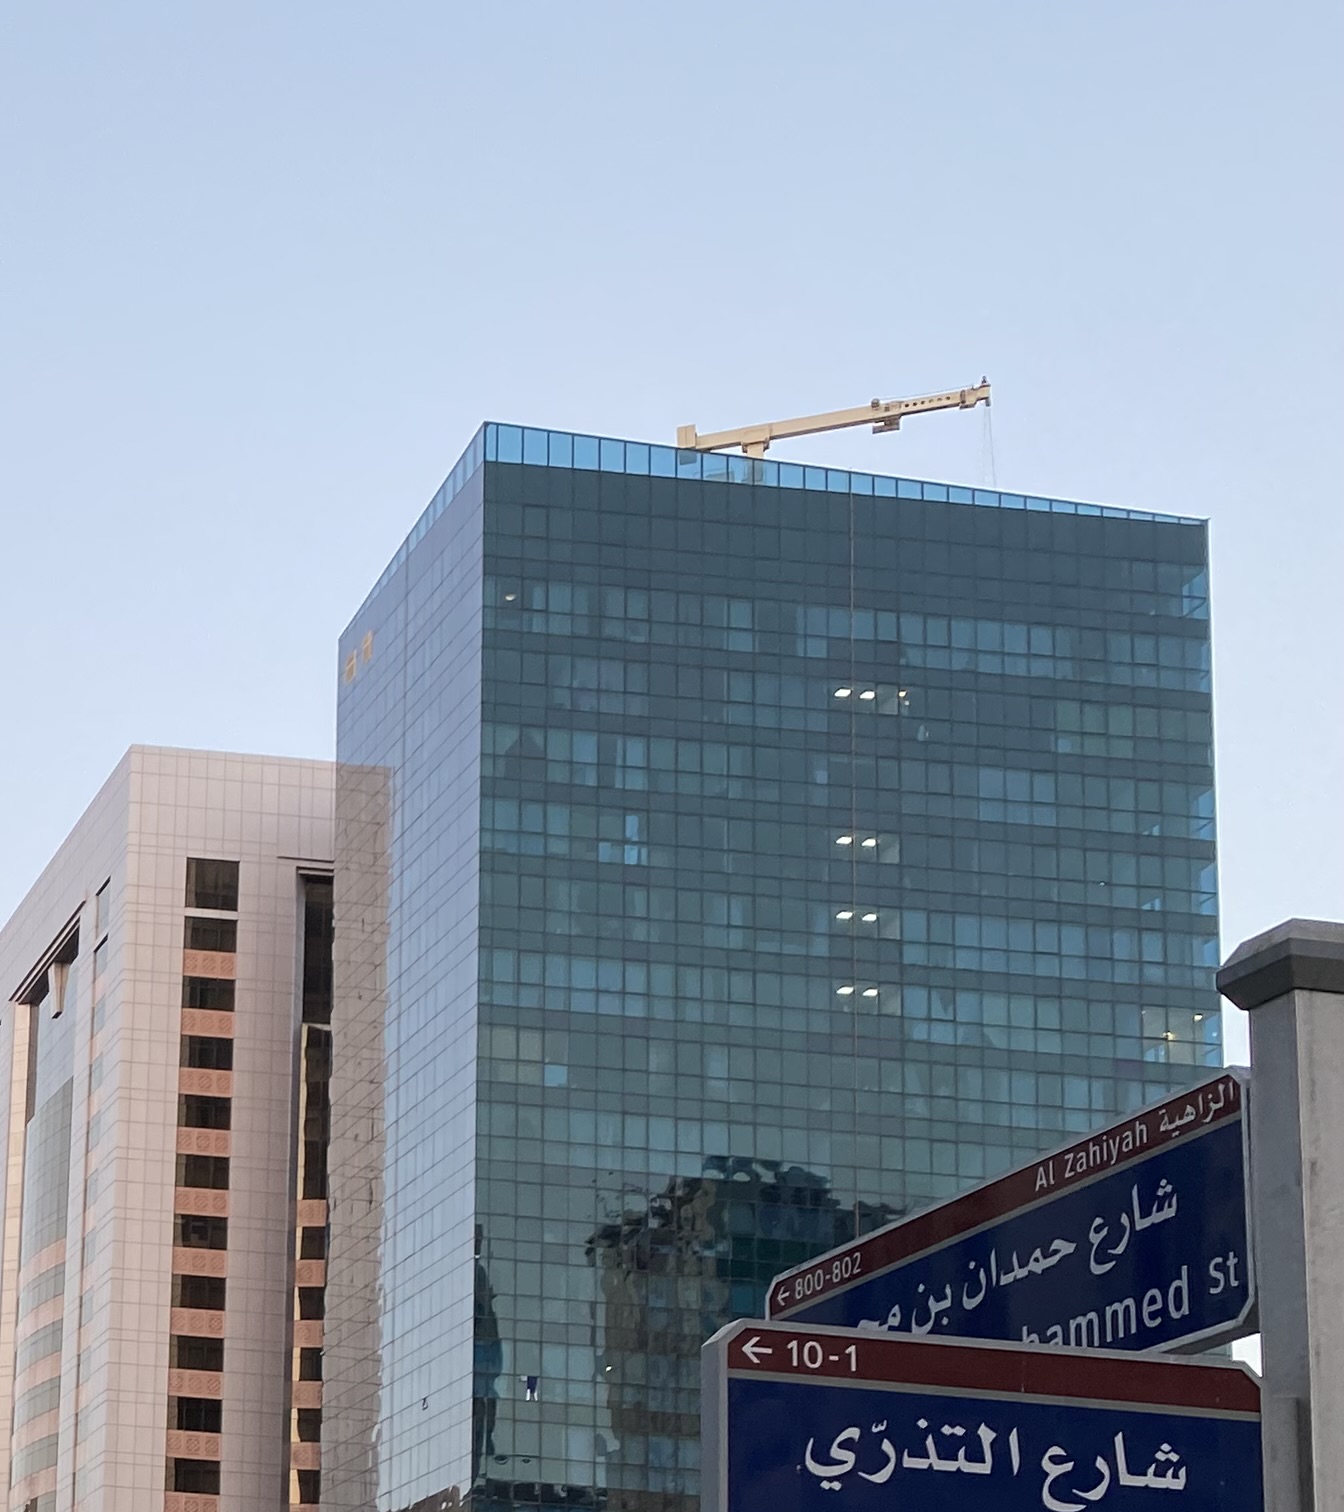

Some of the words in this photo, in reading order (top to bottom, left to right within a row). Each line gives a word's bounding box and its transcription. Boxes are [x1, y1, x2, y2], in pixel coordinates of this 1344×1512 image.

[1158, 1080, 1235, 1139] الزاهية
[1034, 1164, 1056, 1193] Al
[1064, 1121, 1149, 1179] Zahiyah
[1087, 1178, 1179, 1276] شارع
[794, 1252, 863, 1300] 800-802
[962, 1237, 1078, 1311] حمدان
[1209, 1250, 1240, 1297] St
[911, 1280, 953, 1335] بن
[786, 1339, 859, 1373] 10-1
